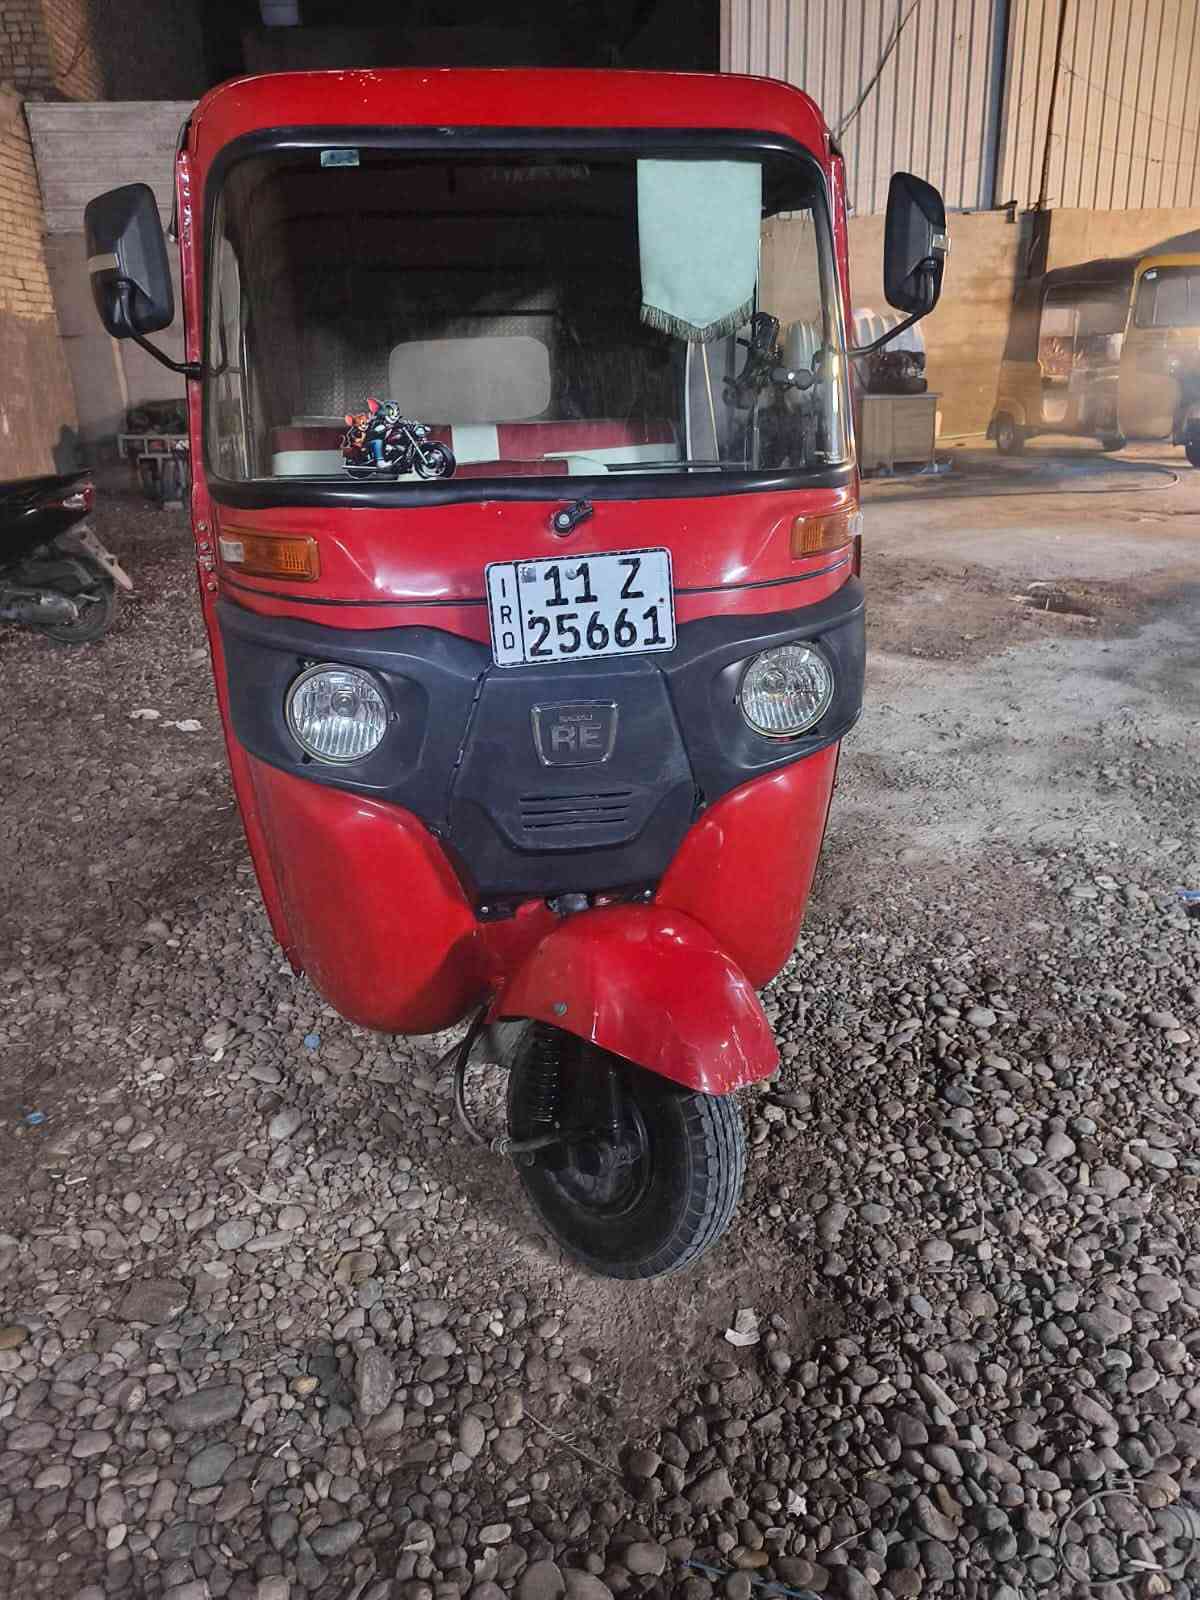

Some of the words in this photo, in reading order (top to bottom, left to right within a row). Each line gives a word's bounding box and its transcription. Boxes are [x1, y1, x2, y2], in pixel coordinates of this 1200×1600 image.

[543, 562, 598, 608] 11
[617, 557, 645, 600] Z
[527, 605, 667, 657] 25661
[551, 724, 602, 752] RE
